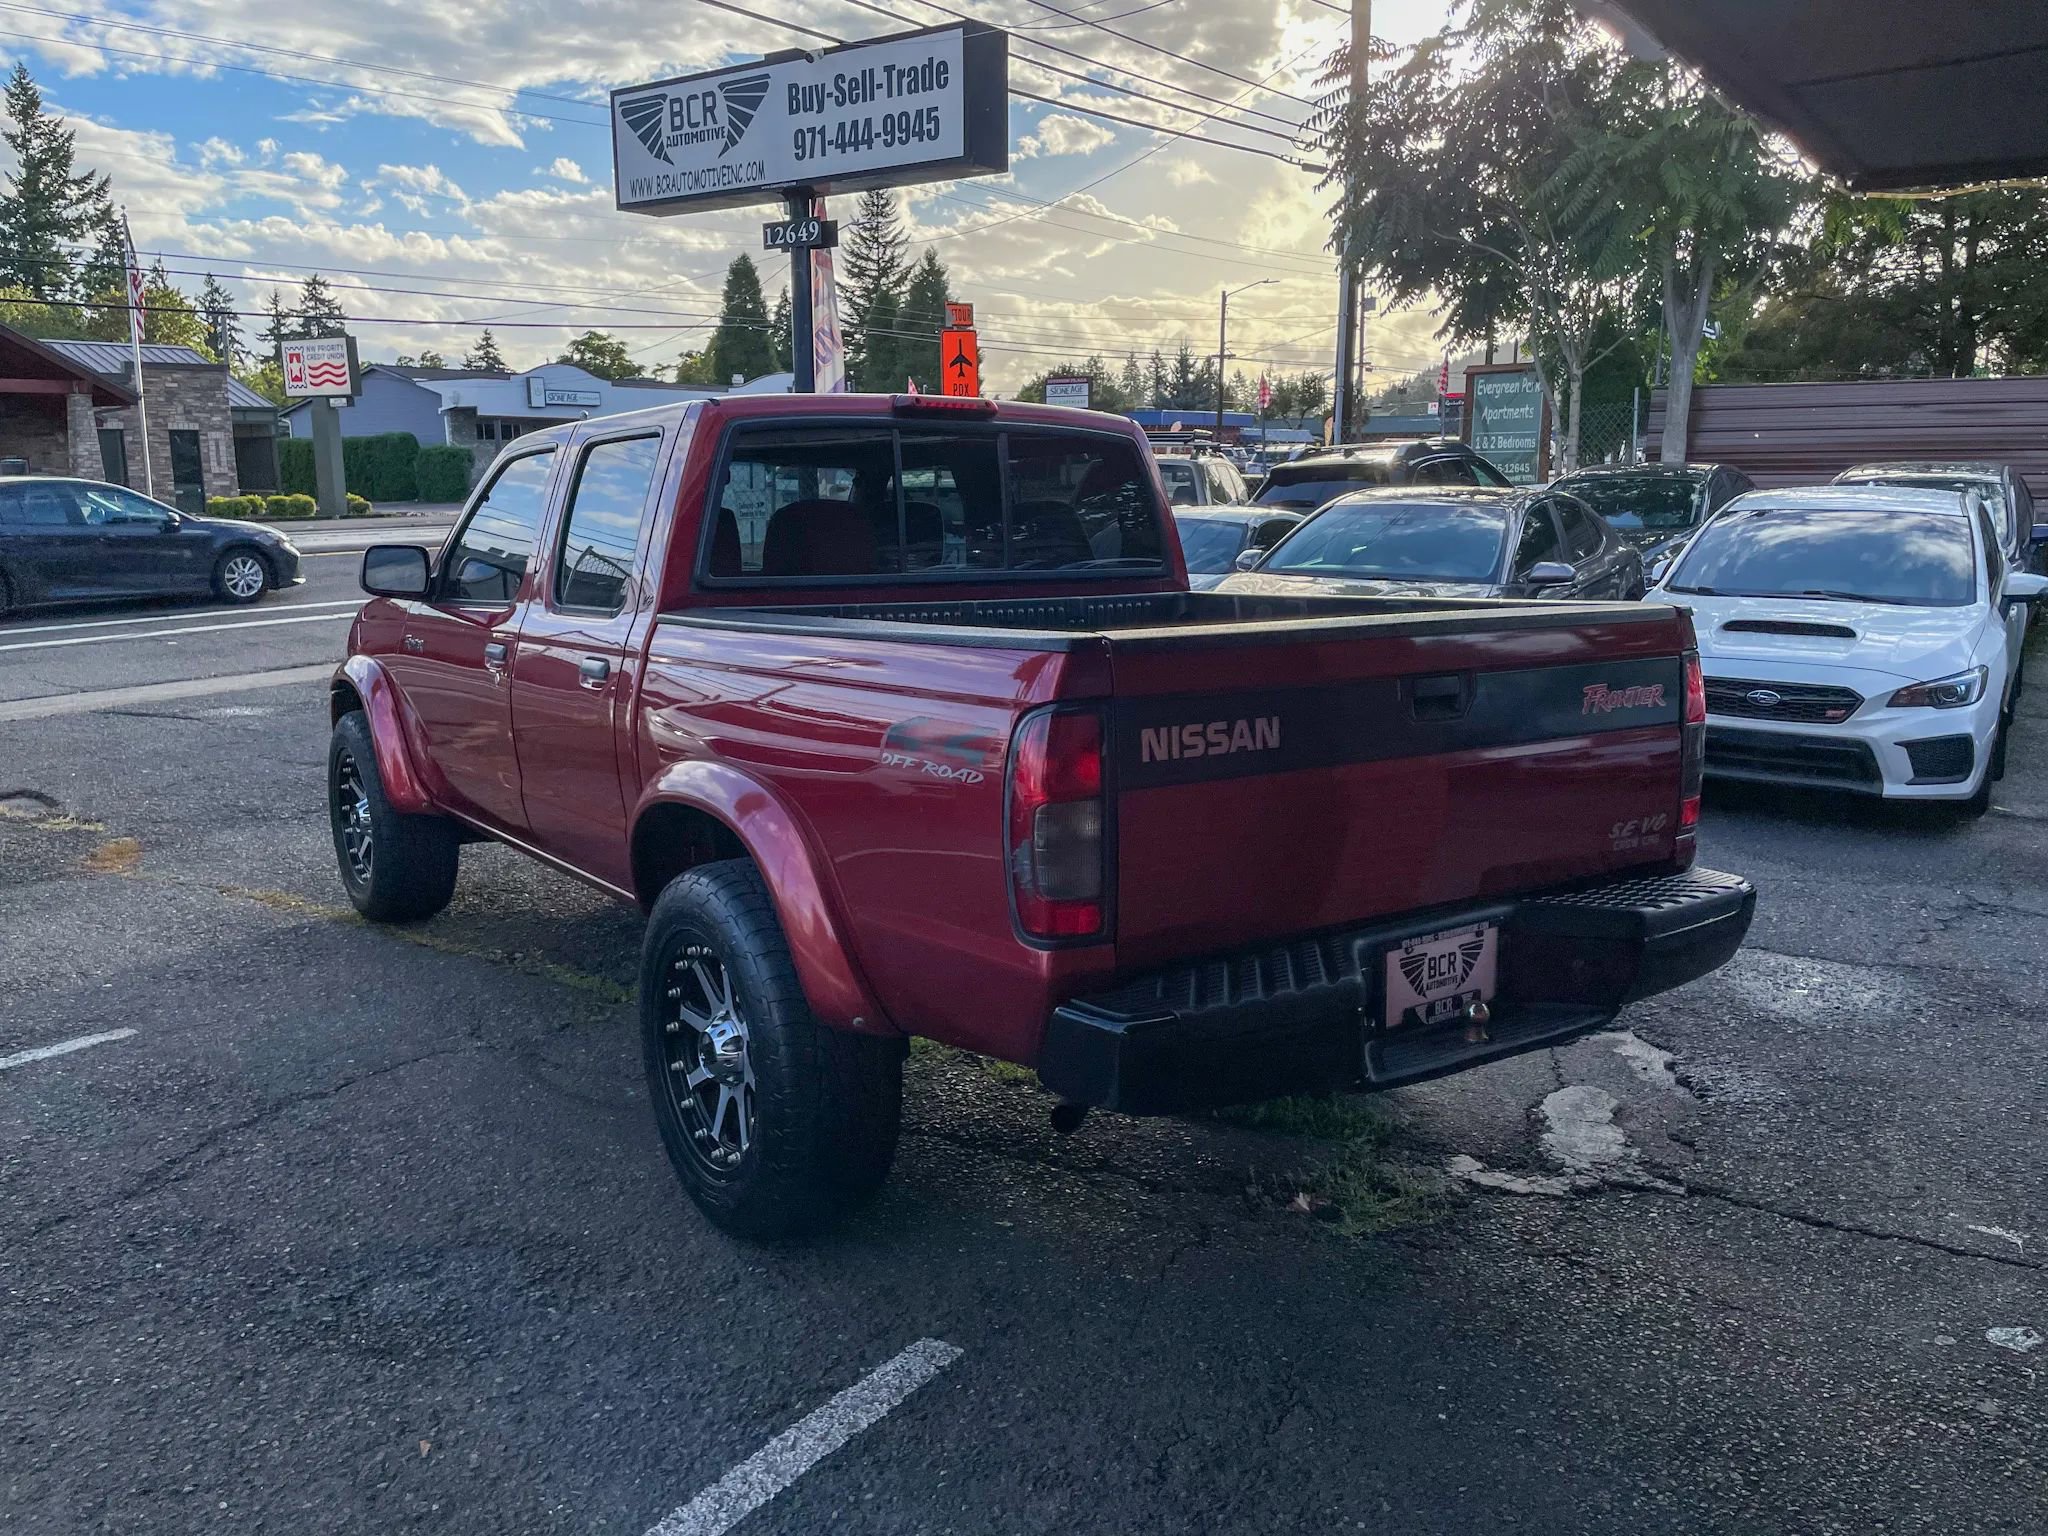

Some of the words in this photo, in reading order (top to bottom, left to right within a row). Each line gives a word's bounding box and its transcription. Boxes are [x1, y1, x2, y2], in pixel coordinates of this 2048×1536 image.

[787, 56, 949, 116] Buy-Sell-Trade
[669, 90, 718, 132] BCR
[666, 126, 726, 149] AUTOMOTIVE
[793, 105, 940, 161] 971-444-9945
[629, 160, 766, 199] WWW.BCRAUTOMOTIVEINC.COM
[765, 220, 819, 246] 12649
[306, 344, 316, 352] NW
[317, 343, 344, 351] PRIORITY
[326, 352, 345, 360] UNION
[953, 383, 969, 396] PDX
[1050, 386, 1070, 395] STONE
[1071, 384, 1085, 393] AGE
[1477, 379, 1520, 398] Evergreen
[1481, 404, 1535, 424] Apartments
[1475, 437, 1480, 449] 1
[1482, 436, 1488, 448] &
[1490, 436, 1496, 448] 2
[1497, 436, 1536, 448] Bedrooms
[1141, 716, 1281, 762] NISSAN
[881, 752, 920, 768] OFF
[921, 760, 984, 784] ROAD
[1608, 819, 1639, 839] SE
[1428, 951, 1457, 979] BCR
[1425, 975, 1459, 991] AUTOMOTIVE
[1435, 997, 1453, 1015] BCR
